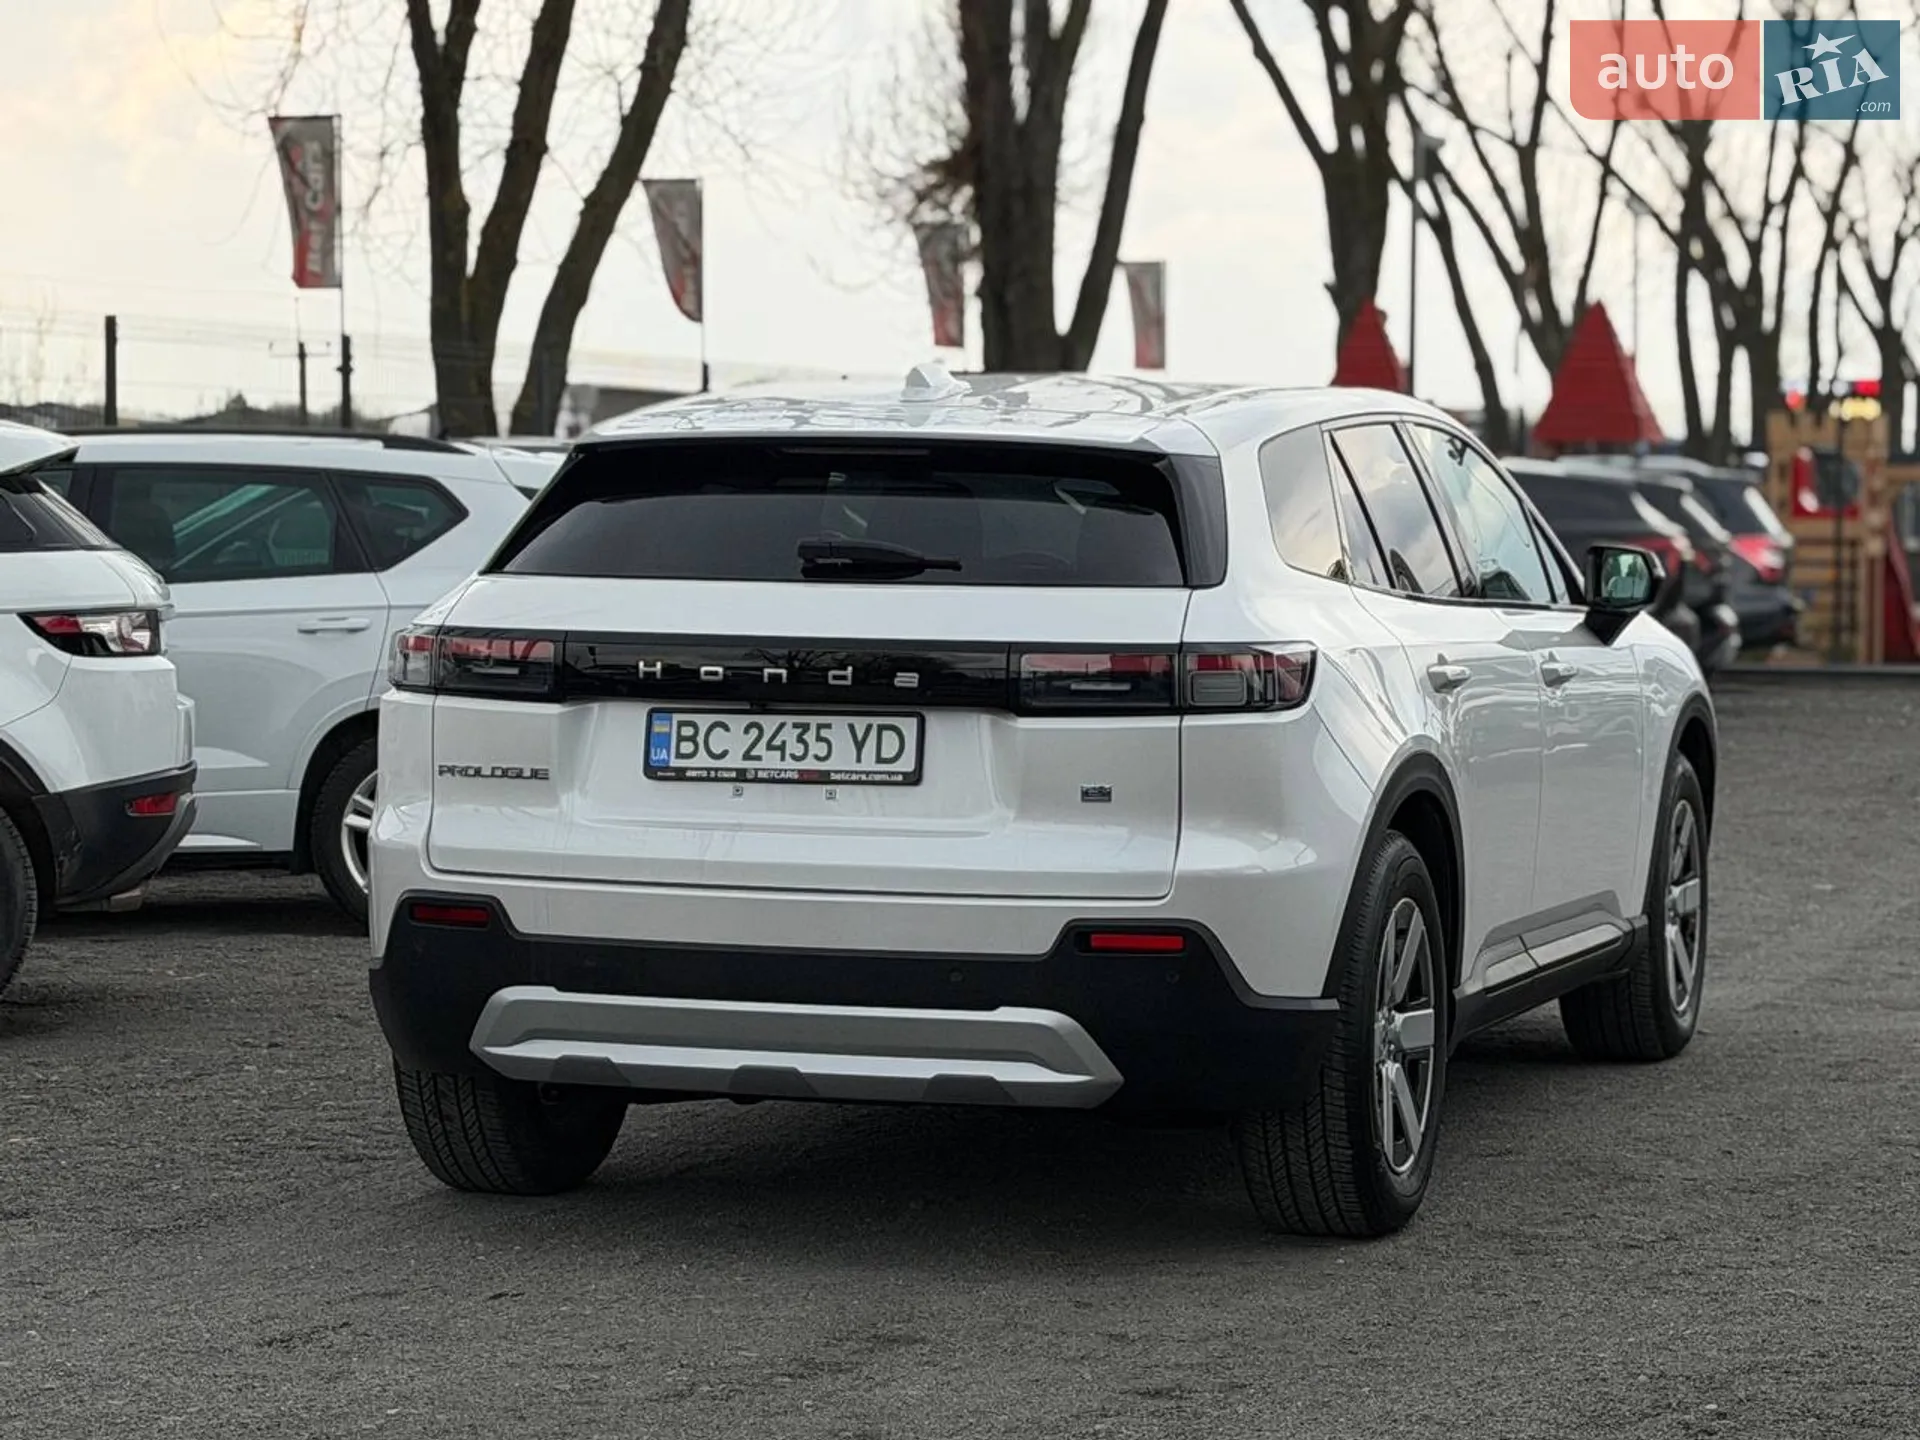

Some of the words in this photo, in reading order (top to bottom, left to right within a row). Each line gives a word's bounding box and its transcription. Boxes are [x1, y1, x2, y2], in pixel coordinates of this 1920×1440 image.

[674, 720, 731, 760] BC
[742, 720, 833, 762] 2435
[848, 723, 906, 765] YD
[652, 747, 668, 761] UA
[438, 764, 550, 780] PROLOGUE
